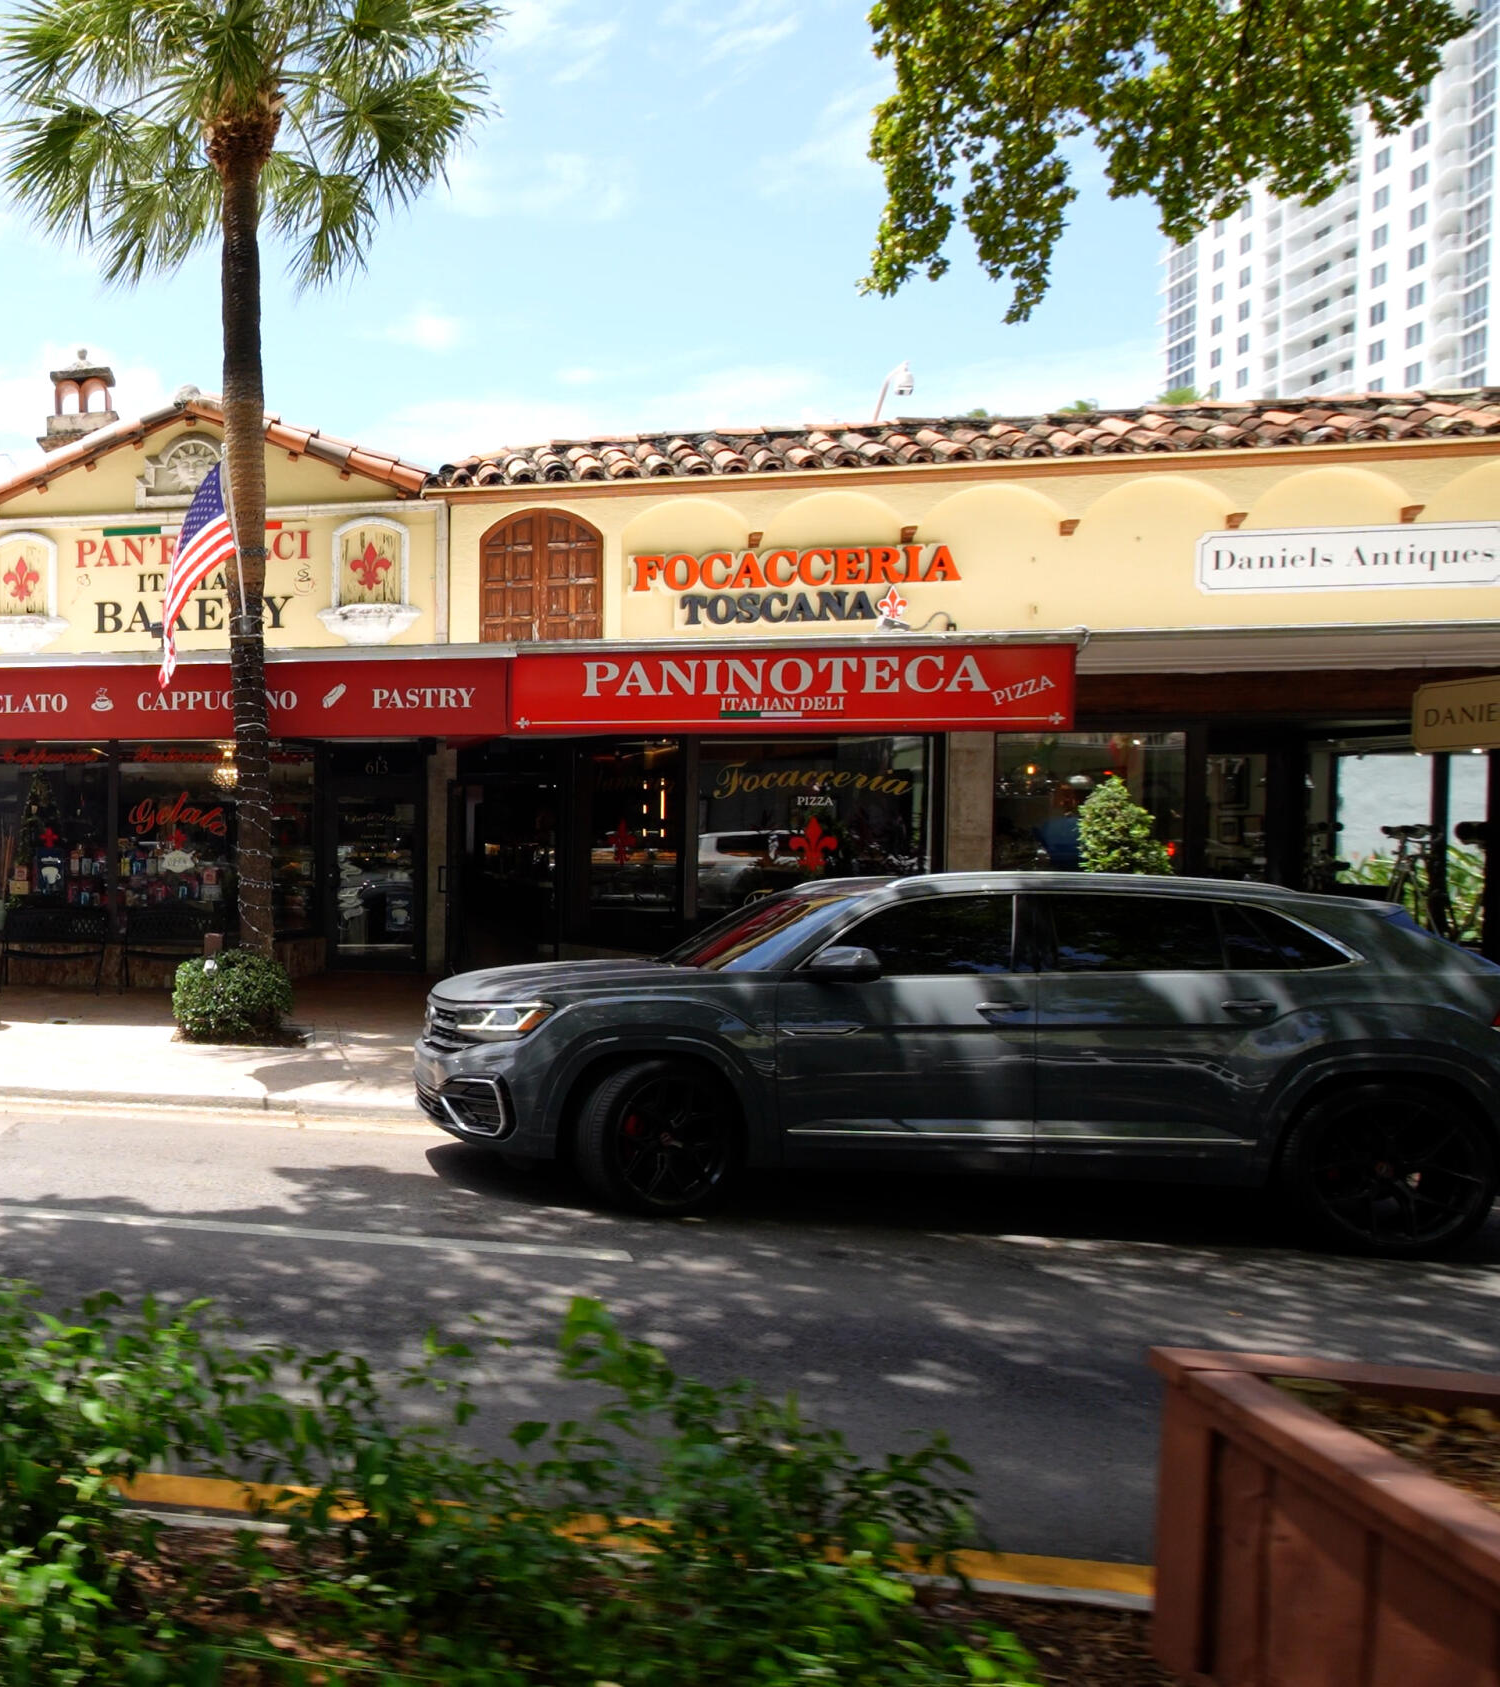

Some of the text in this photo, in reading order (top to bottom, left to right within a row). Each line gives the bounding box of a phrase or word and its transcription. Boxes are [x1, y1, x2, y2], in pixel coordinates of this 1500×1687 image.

[633, 545, 962, 592] FOCACCERIA
[1212, 543, 1495, 572] Daniels Antiques
[137, 572, 227, 593] ITIA
[94, 594, 293, 634] BAEY
[680, 591, 878, 625] TOSCANA
[582, 654, 991, 697] PANINOTECA
[991, 674, 1056, 706] PIZZA
[137, 690, 298, 712] CAPPUCNO
[372, 687, 476, 709] PASTRY
[720, 696, 845, 711] ITALIAN DELI
[365, 760, 388, 775] 613
[712, 761, 912, 799] Focacceria
[128, 791, 227, 836] Gelato
[796, 796, 834, 807] PIZZA
